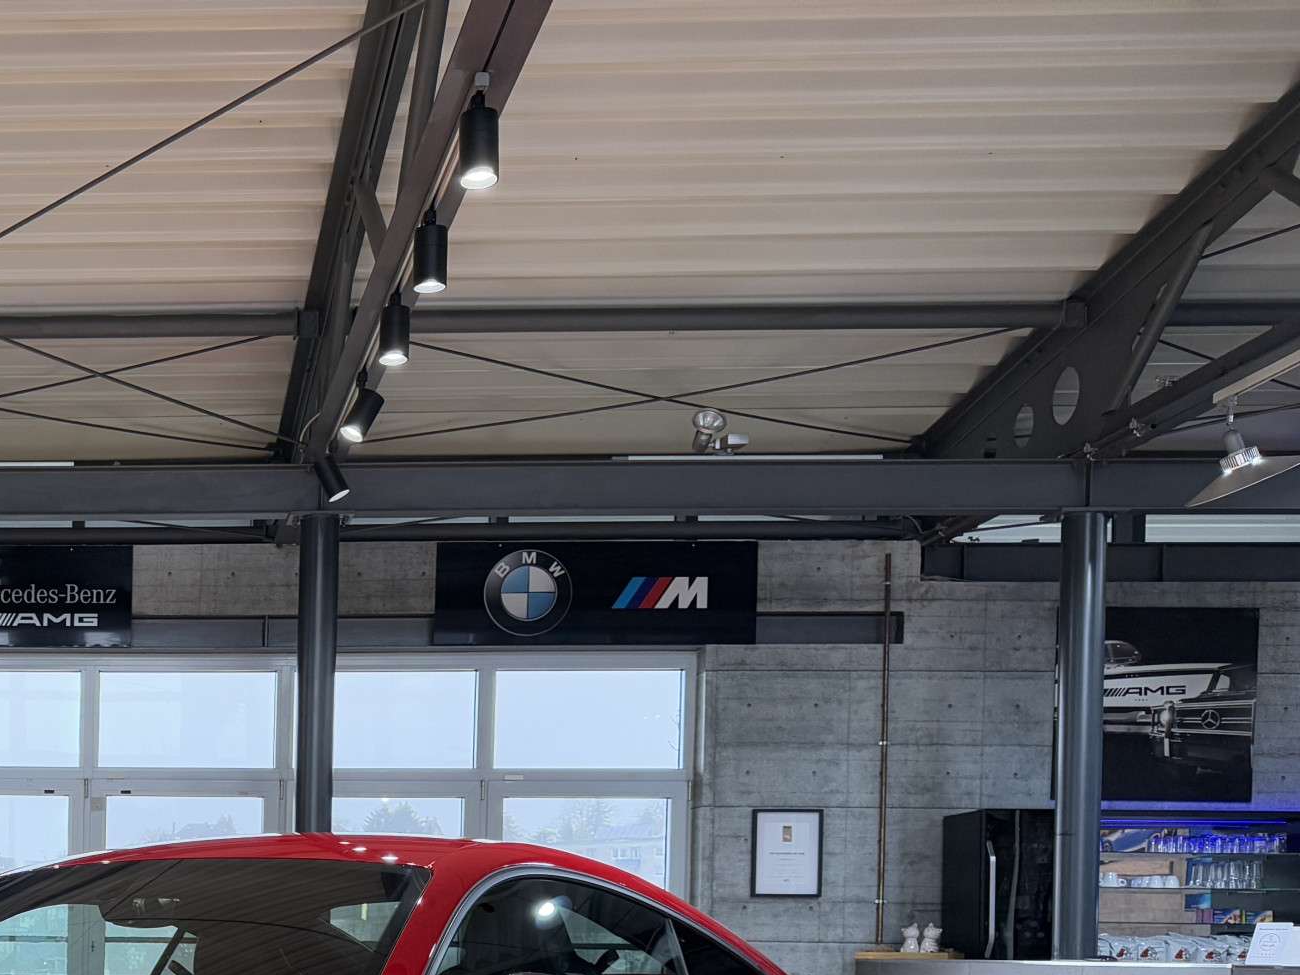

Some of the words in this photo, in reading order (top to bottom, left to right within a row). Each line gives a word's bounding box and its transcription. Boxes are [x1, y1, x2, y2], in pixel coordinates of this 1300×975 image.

[494, 552, 565, 578] BMW
[12, 613, 98, 627] AMG
[1122, 685, 1186, 696] AMG
